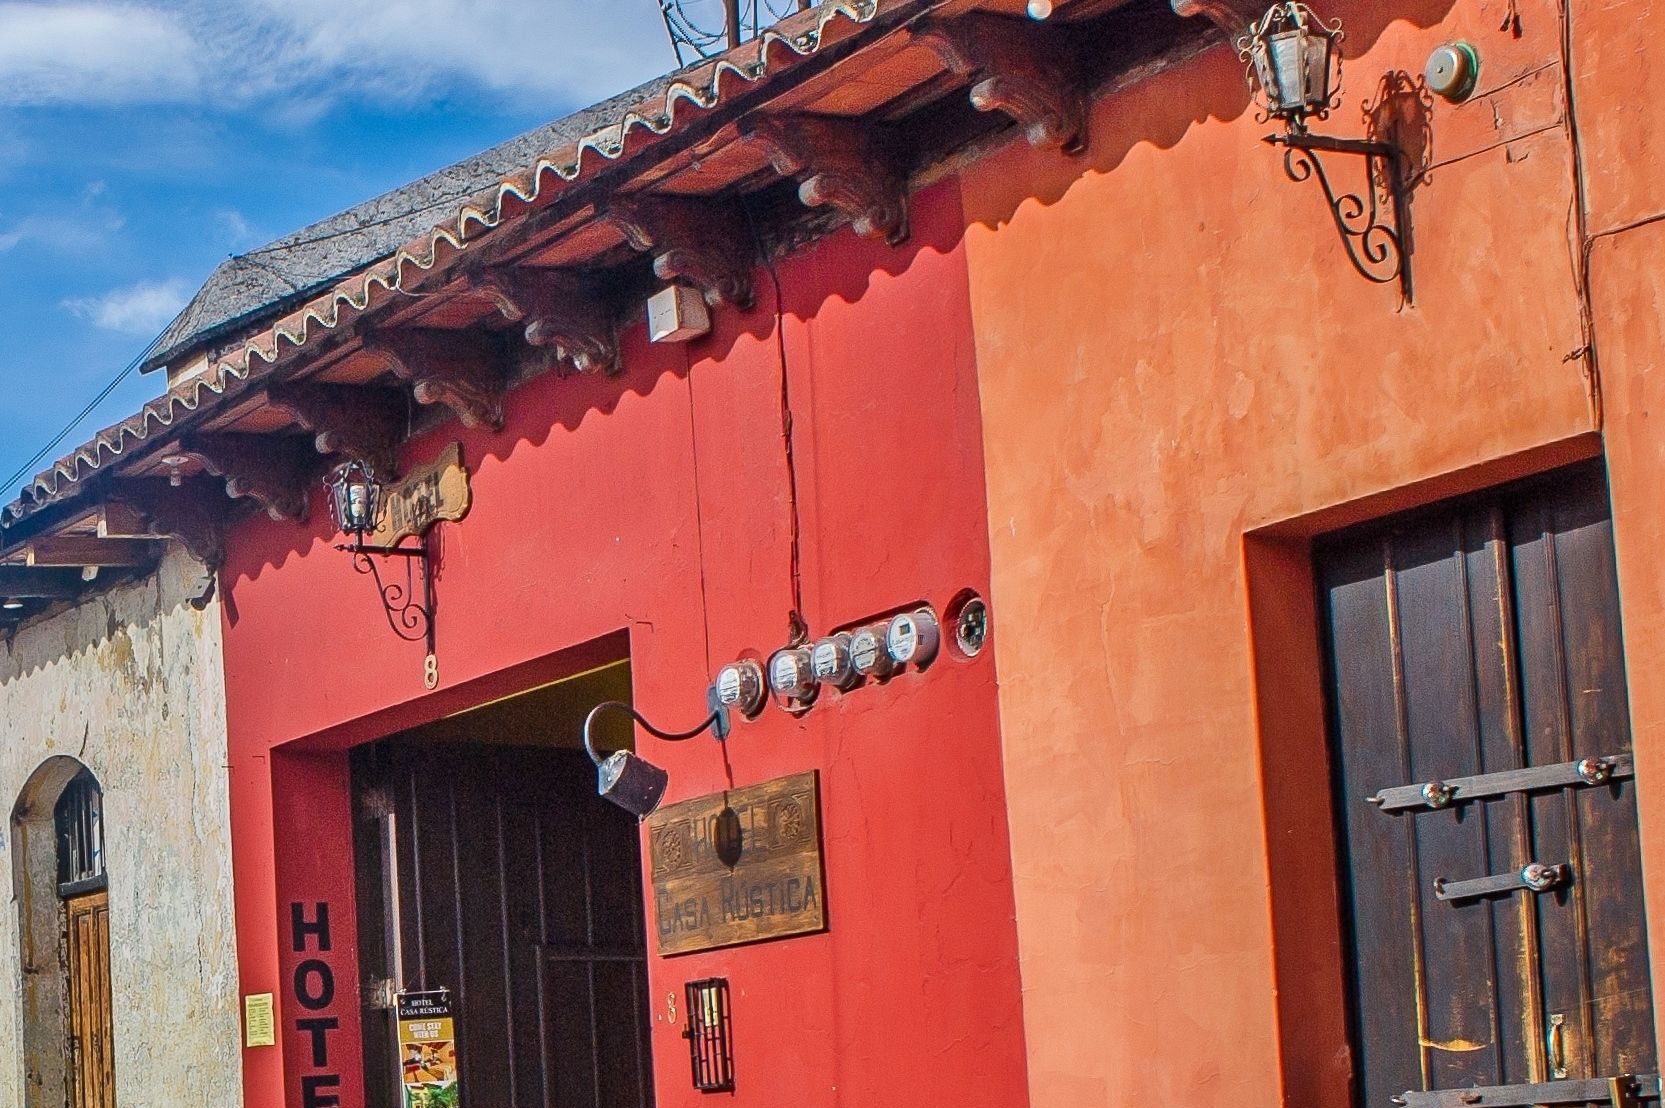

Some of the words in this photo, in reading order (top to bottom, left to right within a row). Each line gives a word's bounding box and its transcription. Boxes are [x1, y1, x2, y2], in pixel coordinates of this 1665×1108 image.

[424, 654, 438, 690] 8
[688, 804, 768, 851] HOEL
[658, 886, 712, 935] CASA
